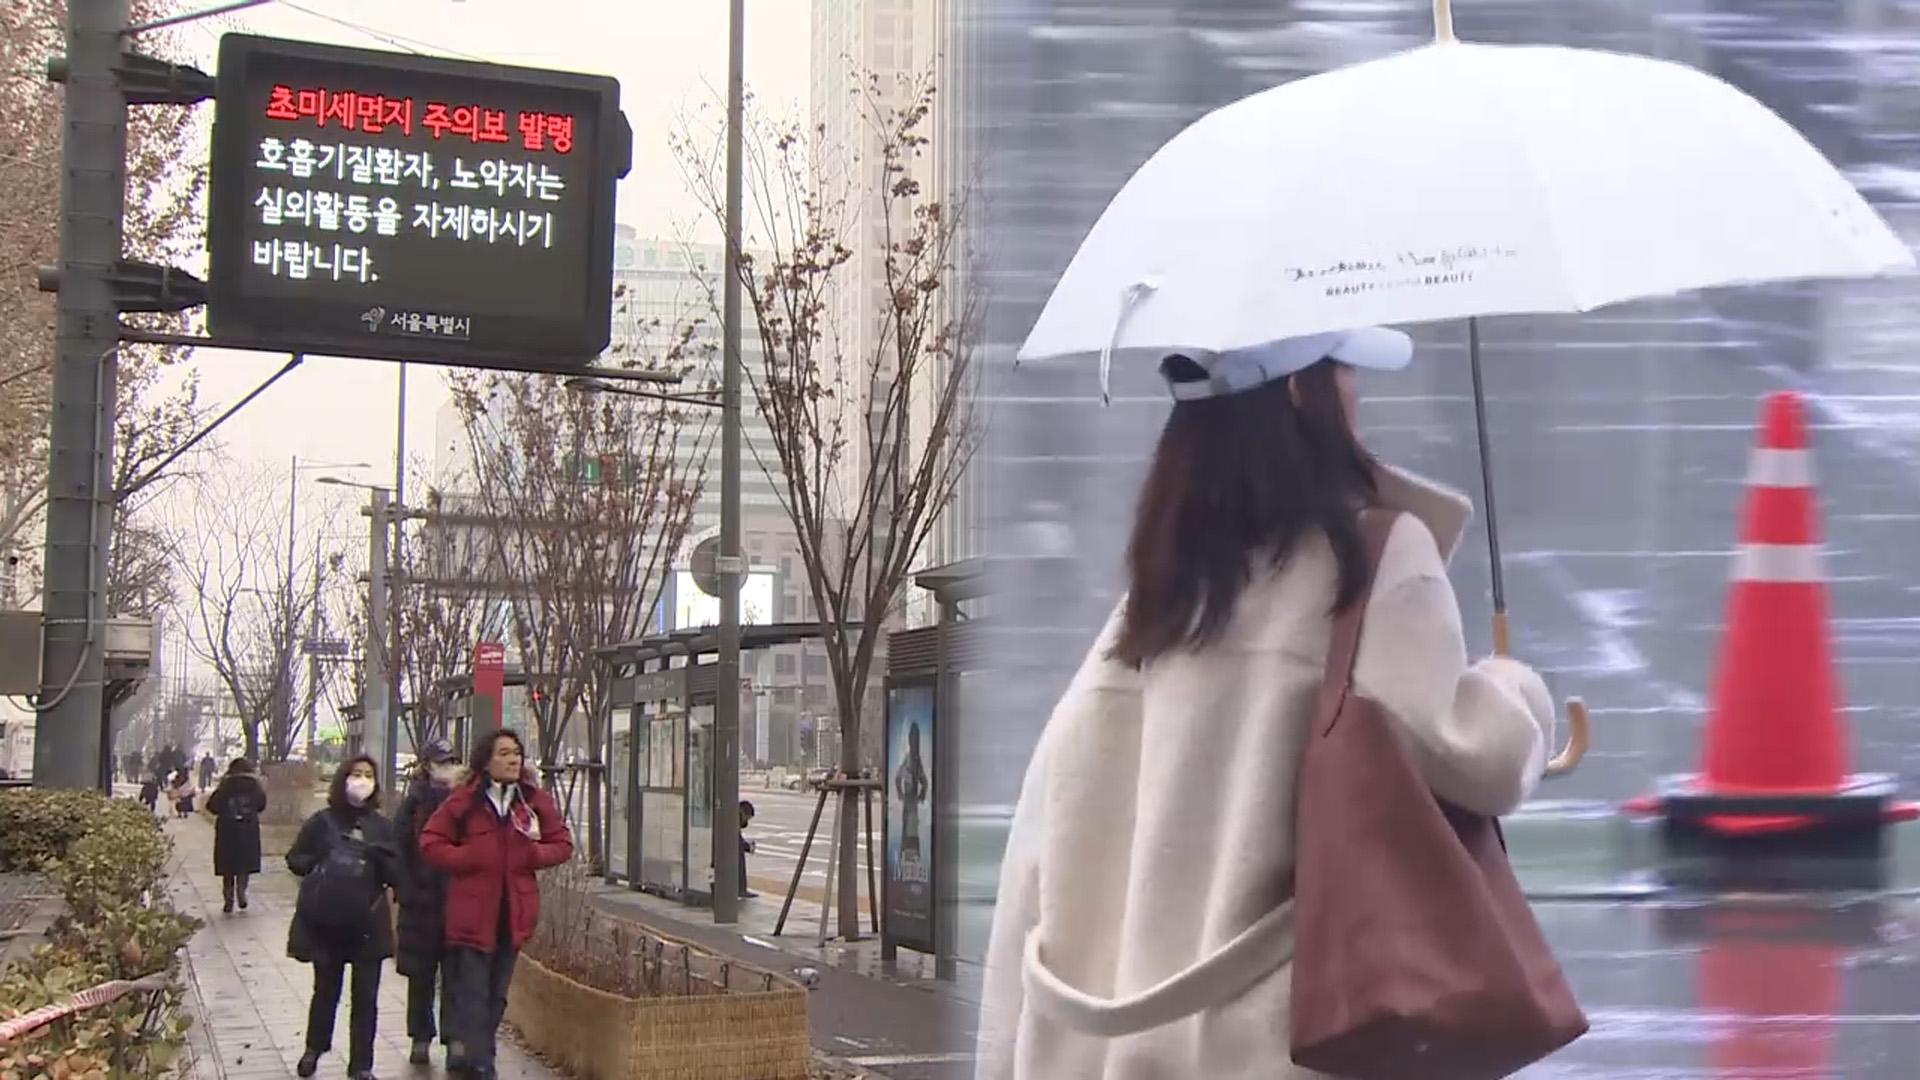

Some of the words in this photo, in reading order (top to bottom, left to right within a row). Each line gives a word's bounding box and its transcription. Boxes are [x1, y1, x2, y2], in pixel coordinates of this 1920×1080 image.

[265, 84, 413, 136] 초미세먼지
[422, 101, 509, 143] 주의보
[518, 112, 573, 153] 발령
[256, 137, 440, 191] 호흡기질환자,
[450, 156, 566, 201] 노약자는
[254, 186, 403, 236] 실외활동을
[412, 202, 553, 249] 자제하시기
[252, 237, 379, 282] 바랍니다.
[391, 312, 470, 336] 서울특별시
